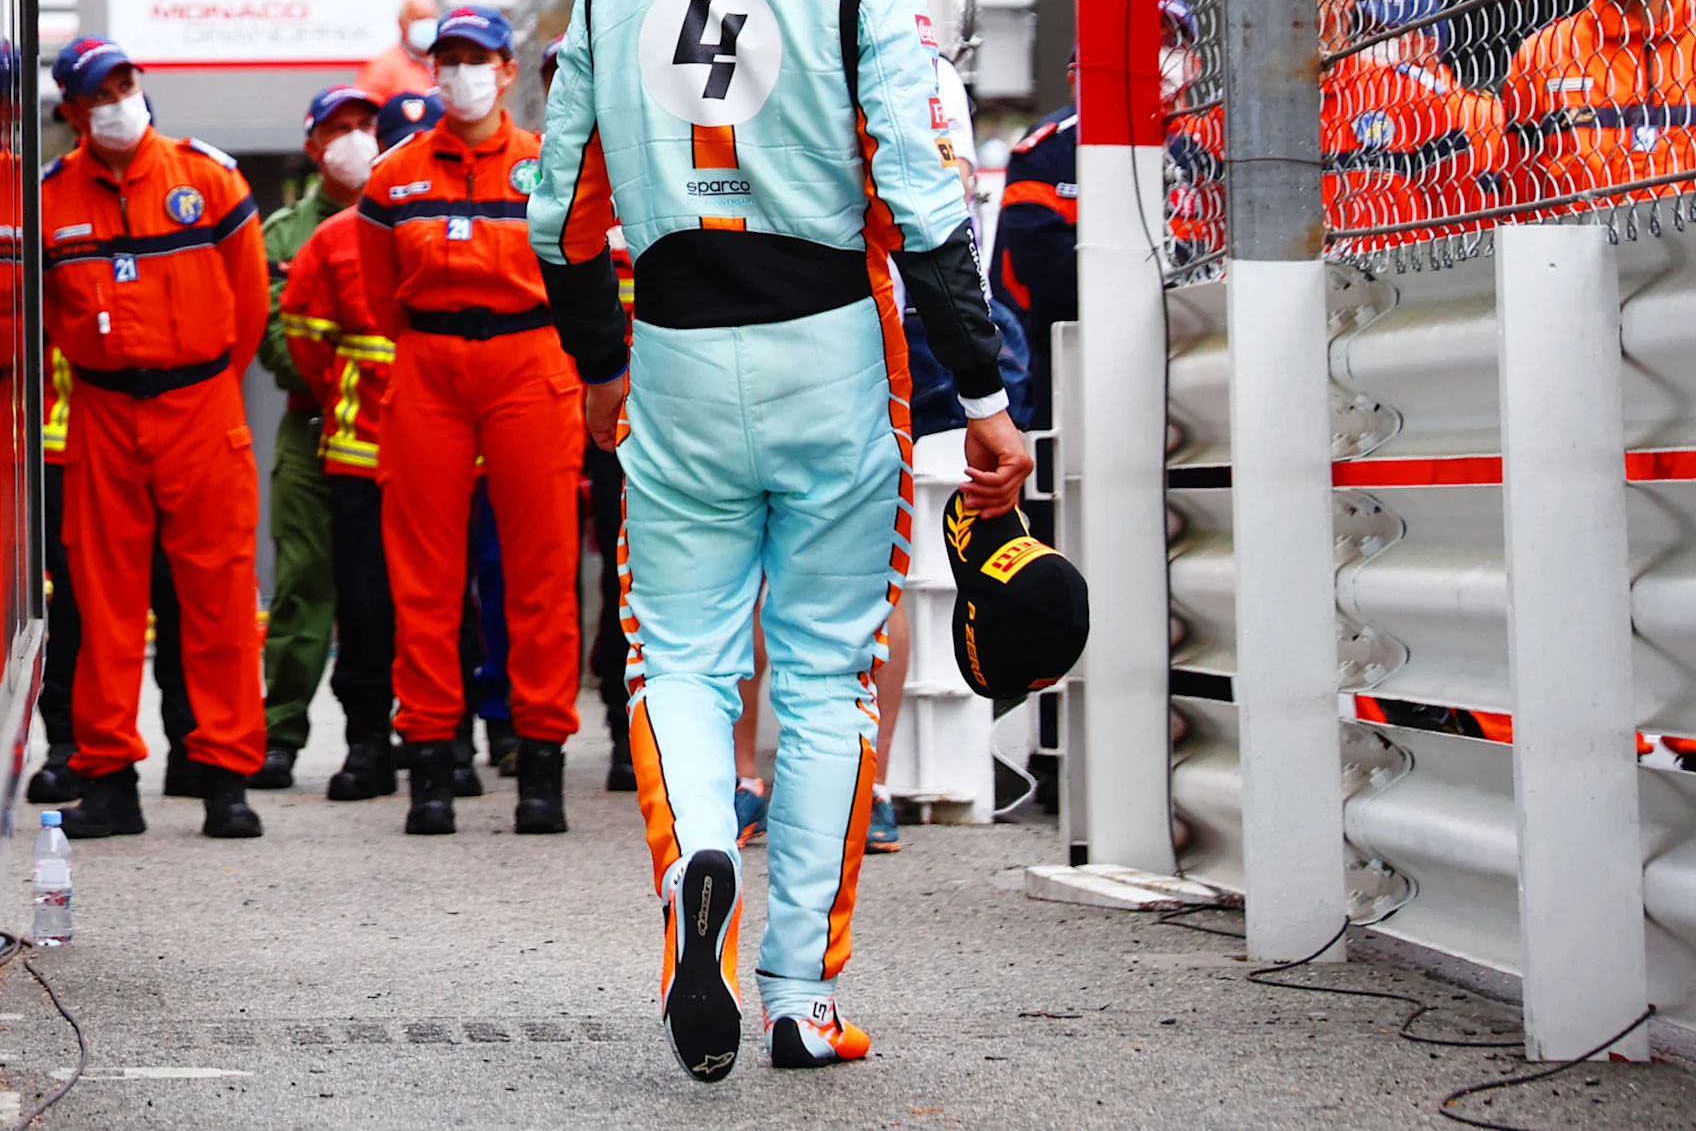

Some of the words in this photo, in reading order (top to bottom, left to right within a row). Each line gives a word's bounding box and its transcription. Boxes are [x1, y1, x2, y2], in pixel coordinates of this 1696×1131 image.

[686, 180, 751, 197] sparco
[115, 256, 137, 281] 21
[965, 622, 990, 690] ZERO
